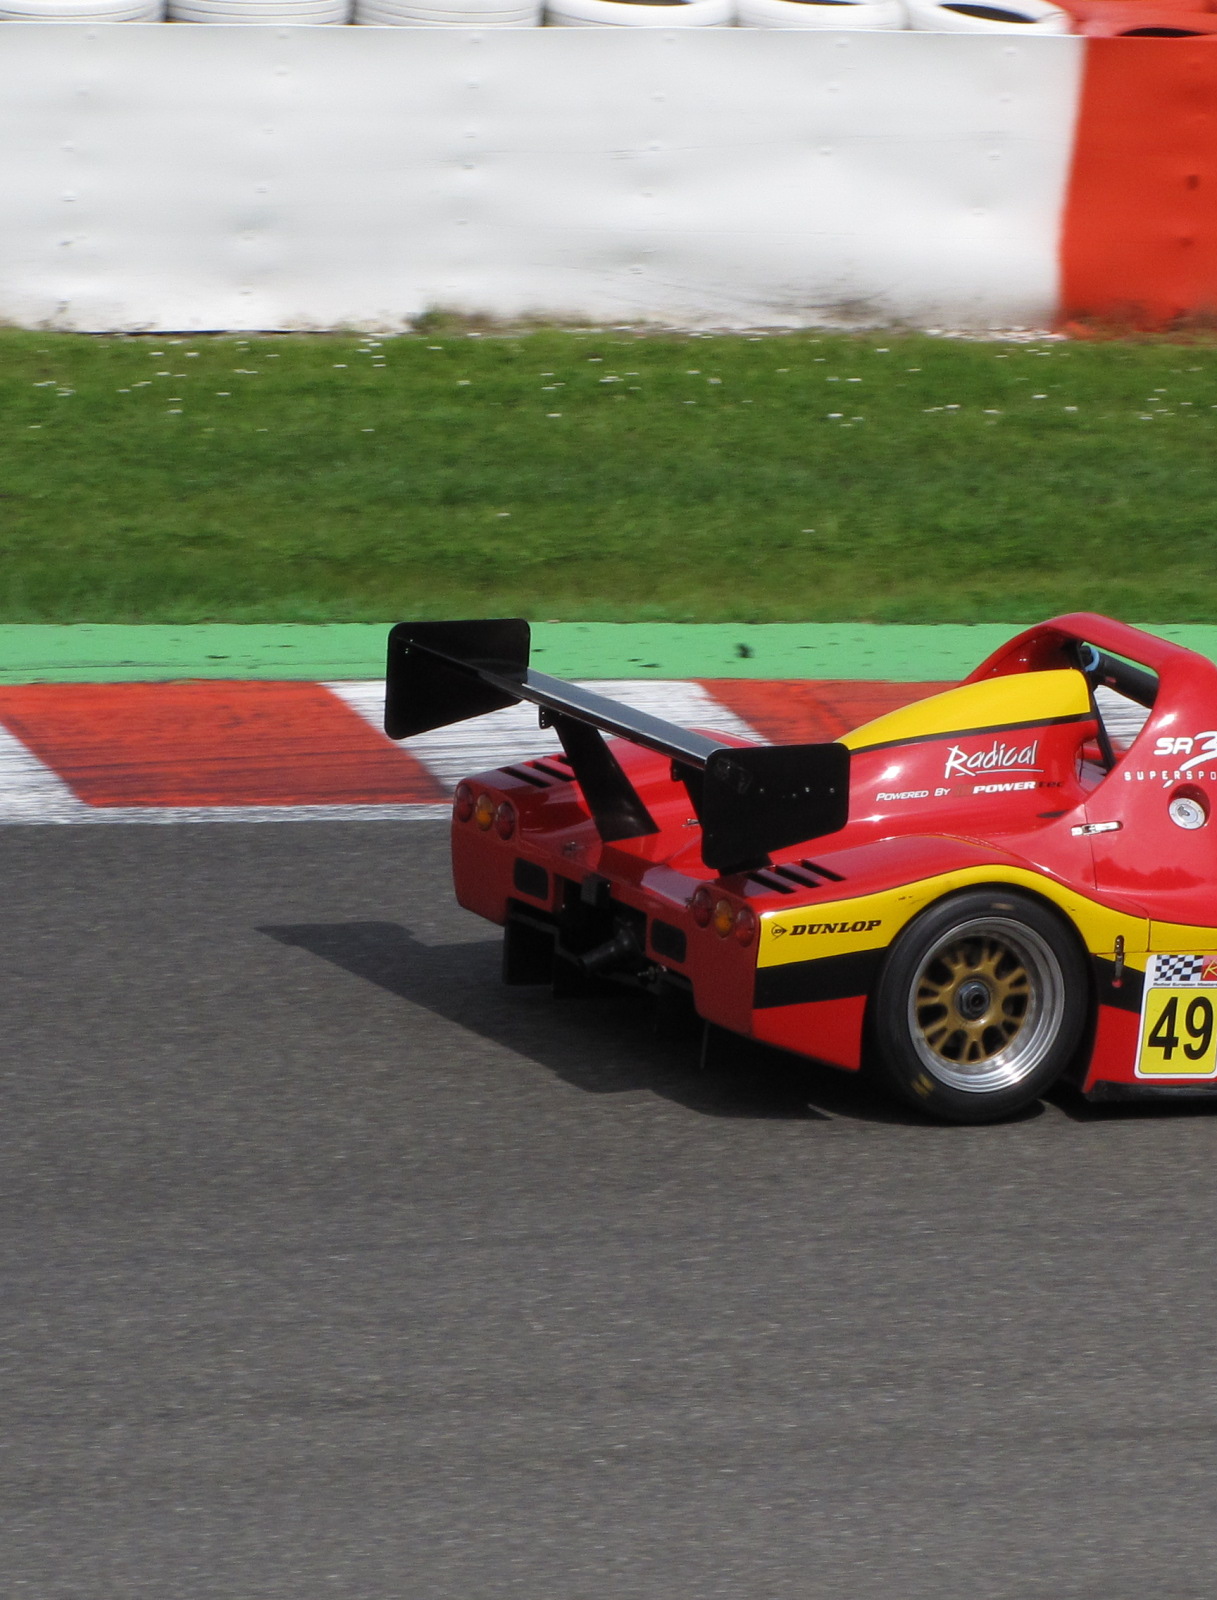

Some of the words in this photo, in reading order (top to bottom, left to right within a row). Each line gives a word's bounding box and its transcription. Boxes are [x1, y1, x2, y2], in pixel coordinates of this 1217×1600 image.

[944, 740, 1039, 779] Radical
[876, 790, 930, 801] POWERED
[789, 920, 882, 936] DUNLOP
[1147, 996, 1214, 1061] 49
